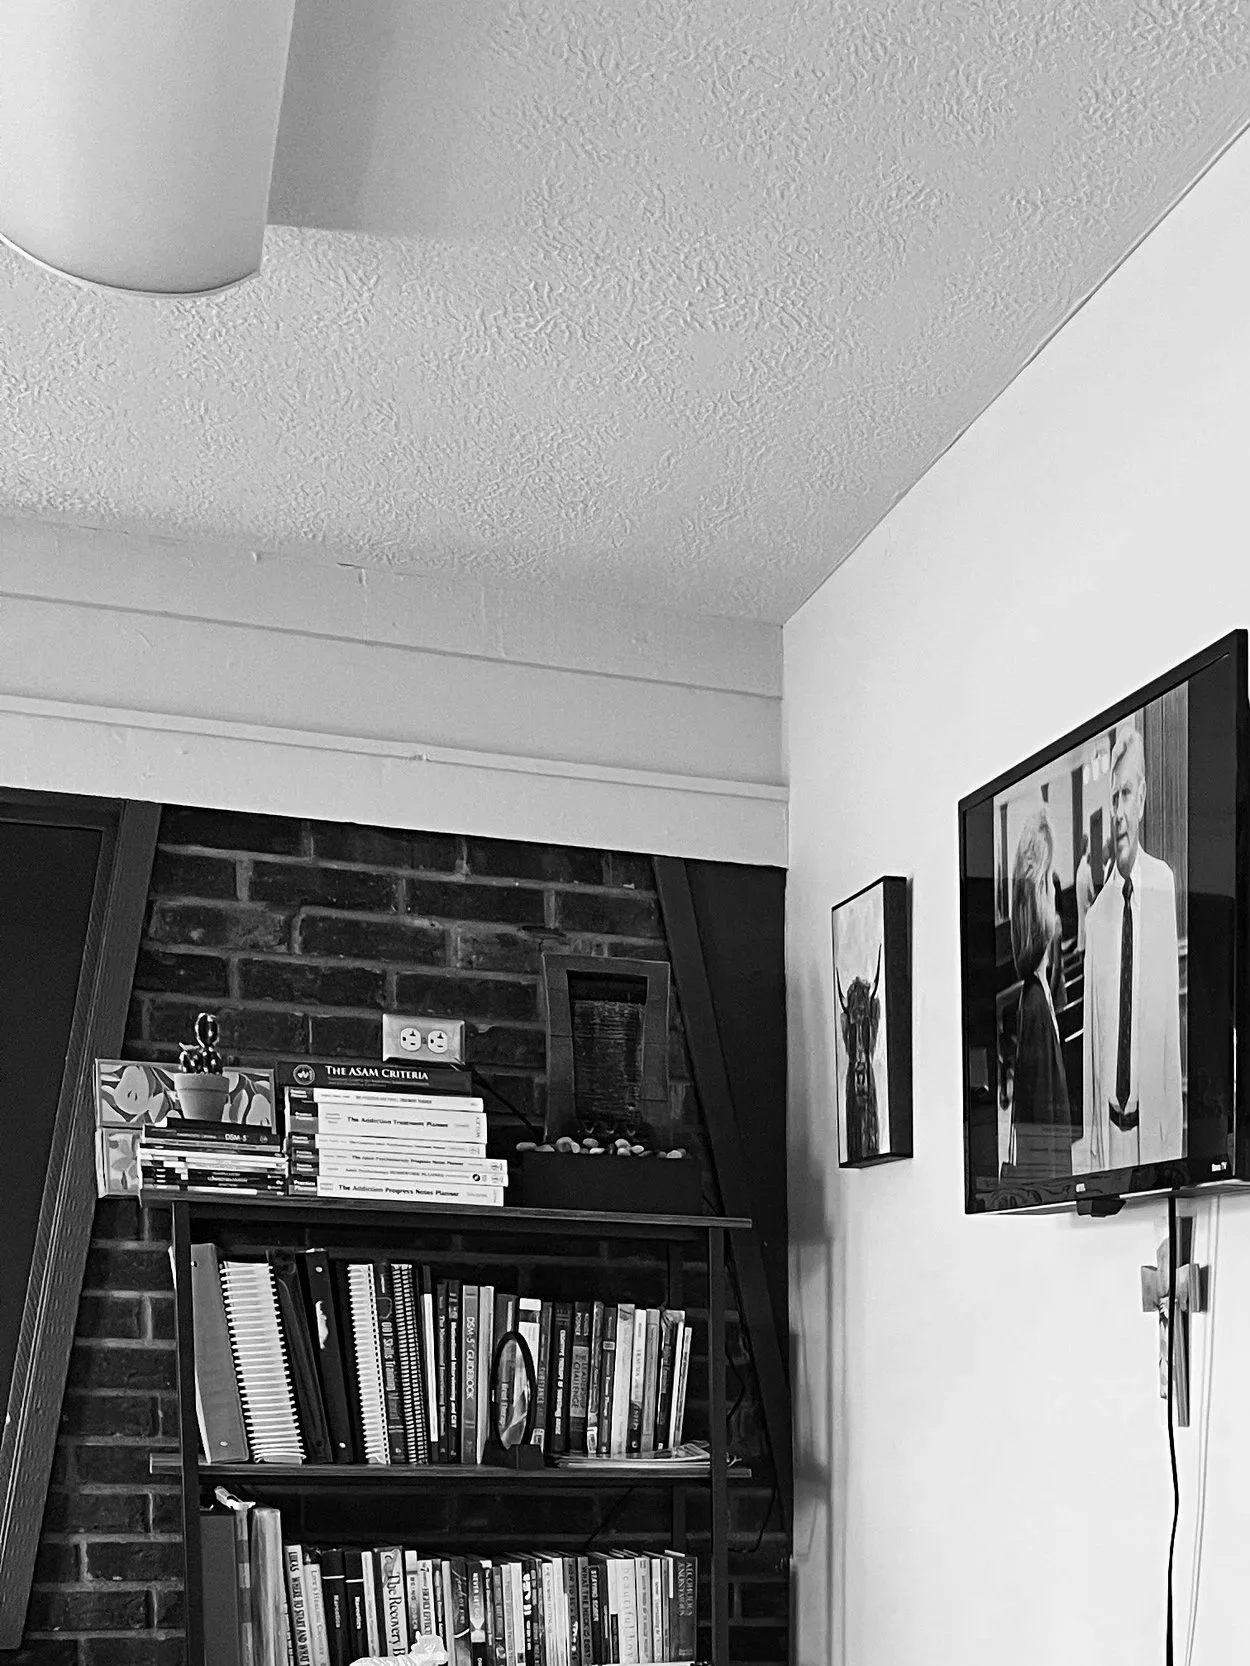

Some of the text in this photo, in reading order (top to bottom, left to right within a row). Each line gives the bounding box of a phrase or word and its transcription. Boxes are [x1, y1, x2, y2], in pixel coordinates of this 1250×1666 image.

[350, 1066, 378, 1077] ASAM
[382, 1069, 428, 1080] CRITERIA
[225, 1133, 247, 1142] DSM-5
[466, 1350, 475, 1400] GUIDEBOOK
[572, 1362, 581, 1408] CHALLENGE
[288, 1552, 299, 1572] LUKAS
[292, 1577, 302, 1597] WHERE
[386, 1572, 400, 1595] The
[294, 1600, 303, 1608] TO
[294, 1610, 305, 1628] START
[389, 1596, 403, 1645] Recovery
[297, 1630, 307, 1643] AND
